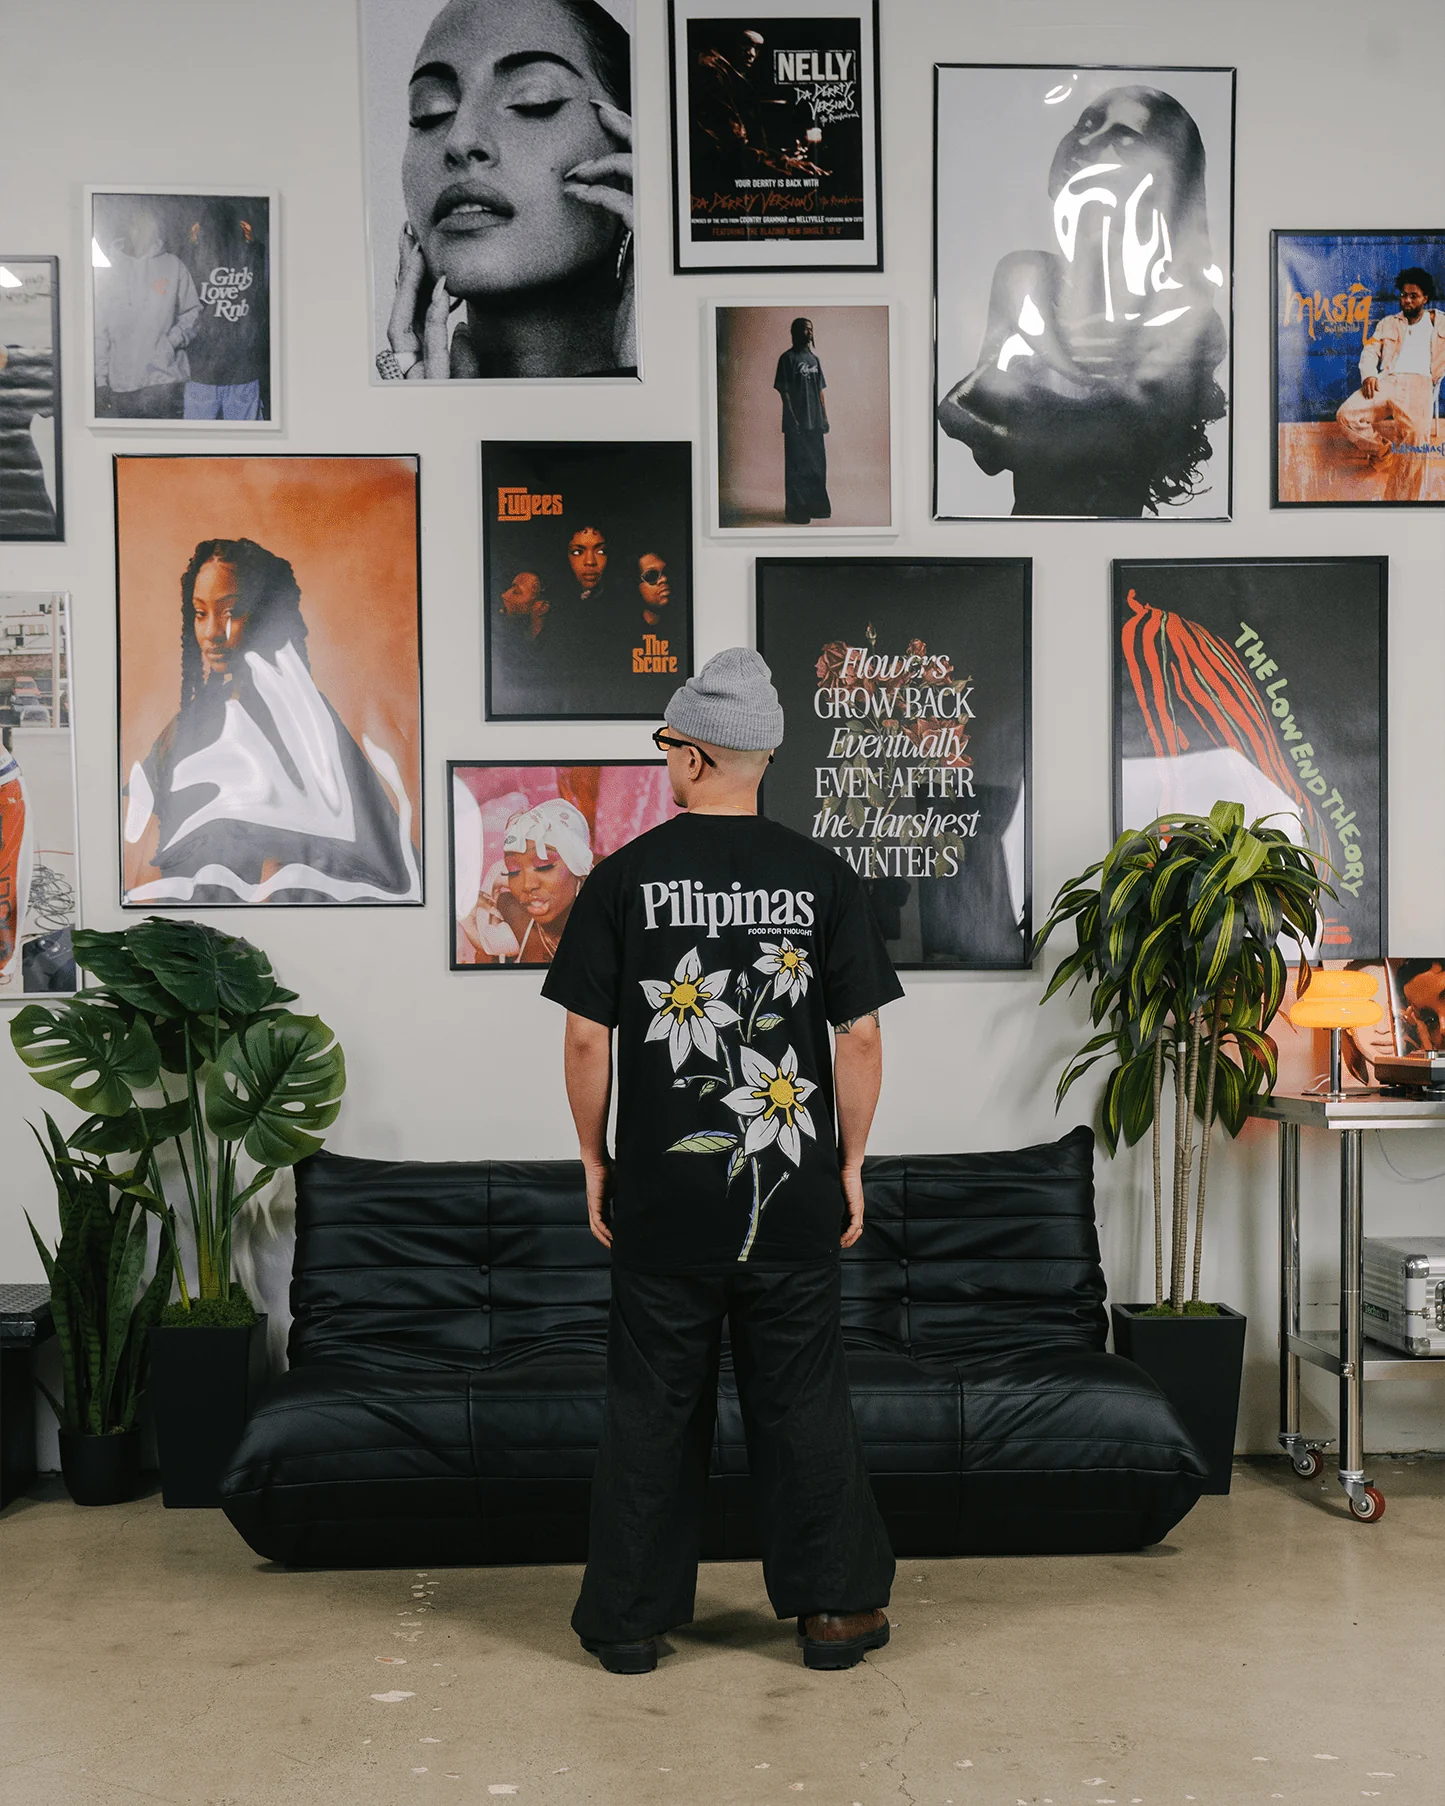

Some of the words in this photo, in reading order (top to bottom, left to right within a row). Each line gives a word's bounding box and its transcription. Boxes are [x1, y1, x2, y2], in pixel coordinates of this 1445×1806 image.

[777, 52, 853, 82] NELLY
[734, 178, 752, 188] YOUR
[752, 178, 777, 188] DERRTY
[777, 178, 785, 188] IS
[785, 178, 802, 188] BACK
[803, 178, 820, 188] WITH
[200, 282, 239, 305] Love
[210, 267, 253, 291] Girls
[213, 299, 250, 322] Rnb
[497, 487, 563, 522] Fugees
[632, 647, 678, 673] Score
[642, 634, 669, 656] The
[839, 647, 950, 680] Flowers
[813, 687, 896, 719] GROW
[904, 687, 976, 719] BACK
[827, 727, 970, 766] Eventually
[1235, 621, 1279, 681] THE
[1265, 678, 1303, 742] LOW
[1289, 742, 1327, 796] END
[1321, 787, 1365, 898] THEORY
[814, 766, 884, 799] EVEN
[887, 766, 977, 799] AFTER
[811, 807, 853, 839] the
[855, 806, 982, 839] Harshest
[640, 879, 815, 938] Pilipinas
[747, 927, 767, 936] FOOD
[767, 927, 782, 935] FOR
[782, 927, 813, 937] THOUGHT
